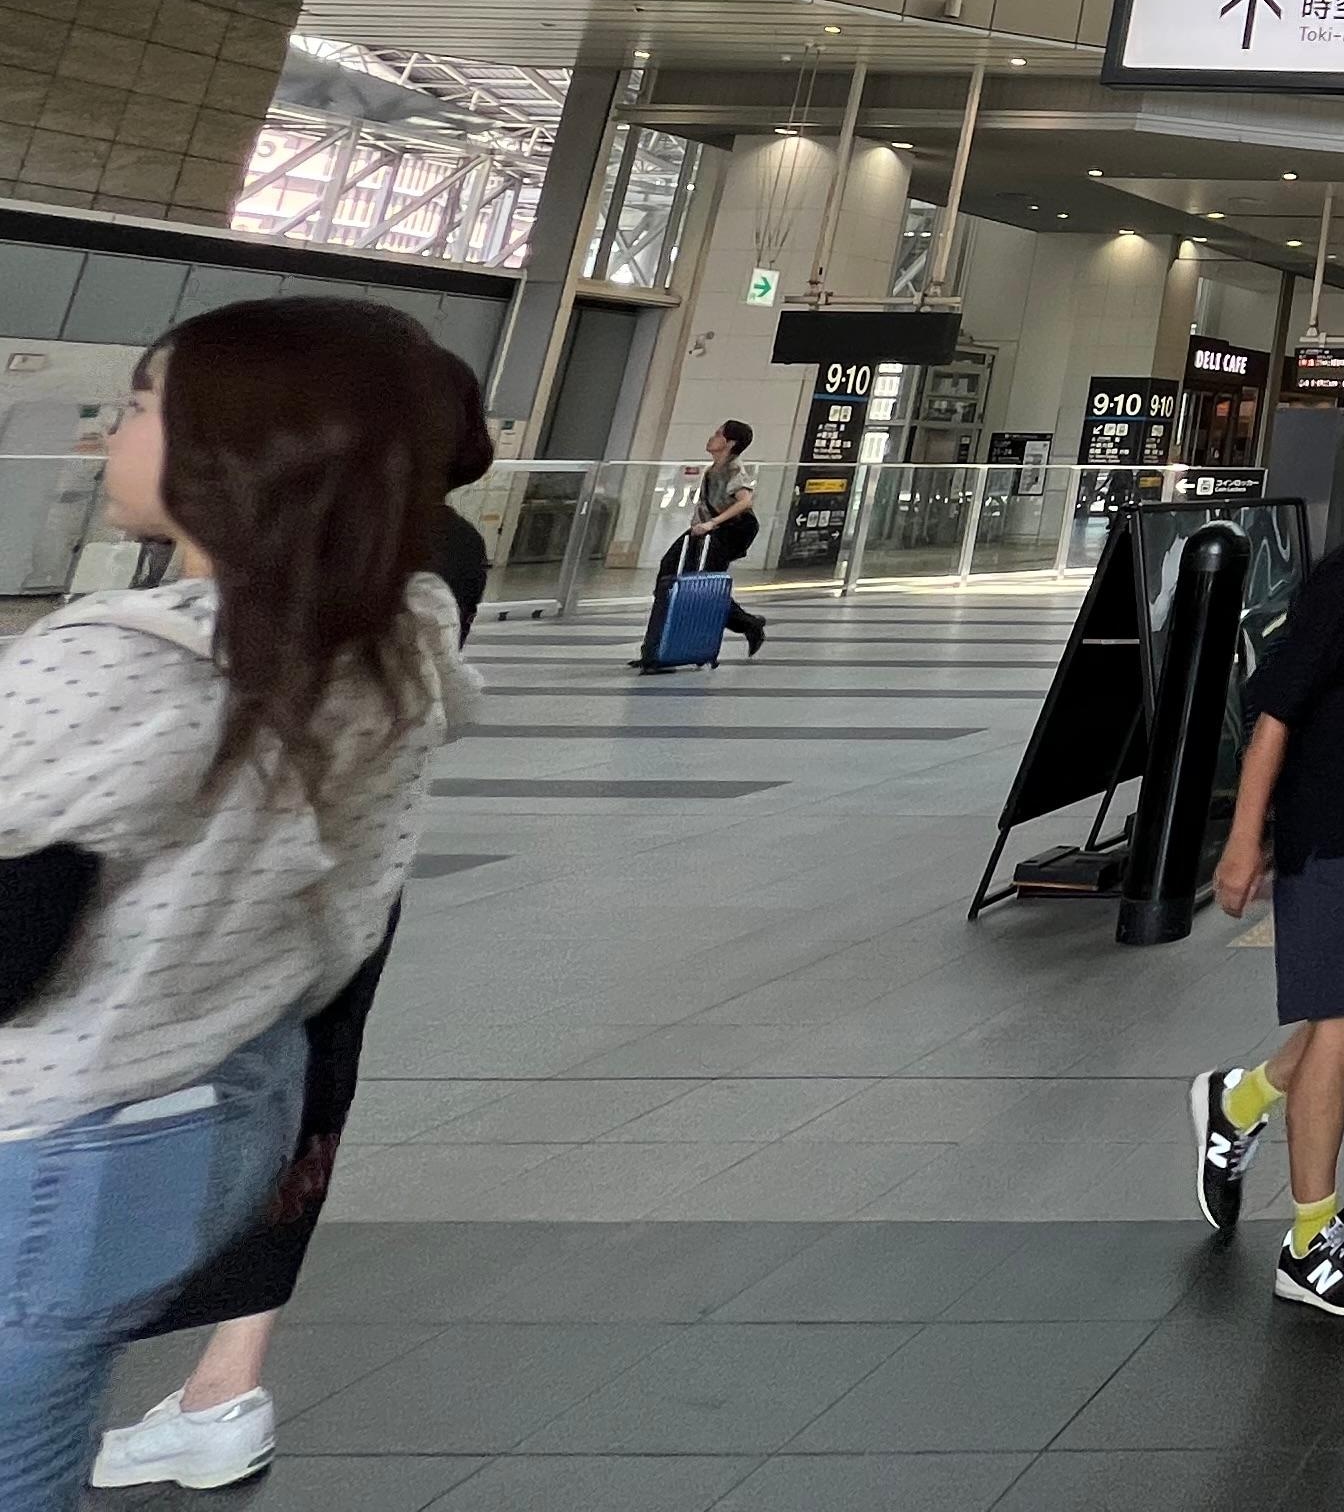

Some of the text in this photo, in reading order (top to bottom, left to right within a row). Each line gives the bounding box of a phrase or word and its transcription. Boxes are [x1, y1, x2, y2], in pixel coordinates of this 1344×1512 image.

[1194, 349, 1248, 375] DELI CAFE
[1306, 1258, 1344, 1295] N
